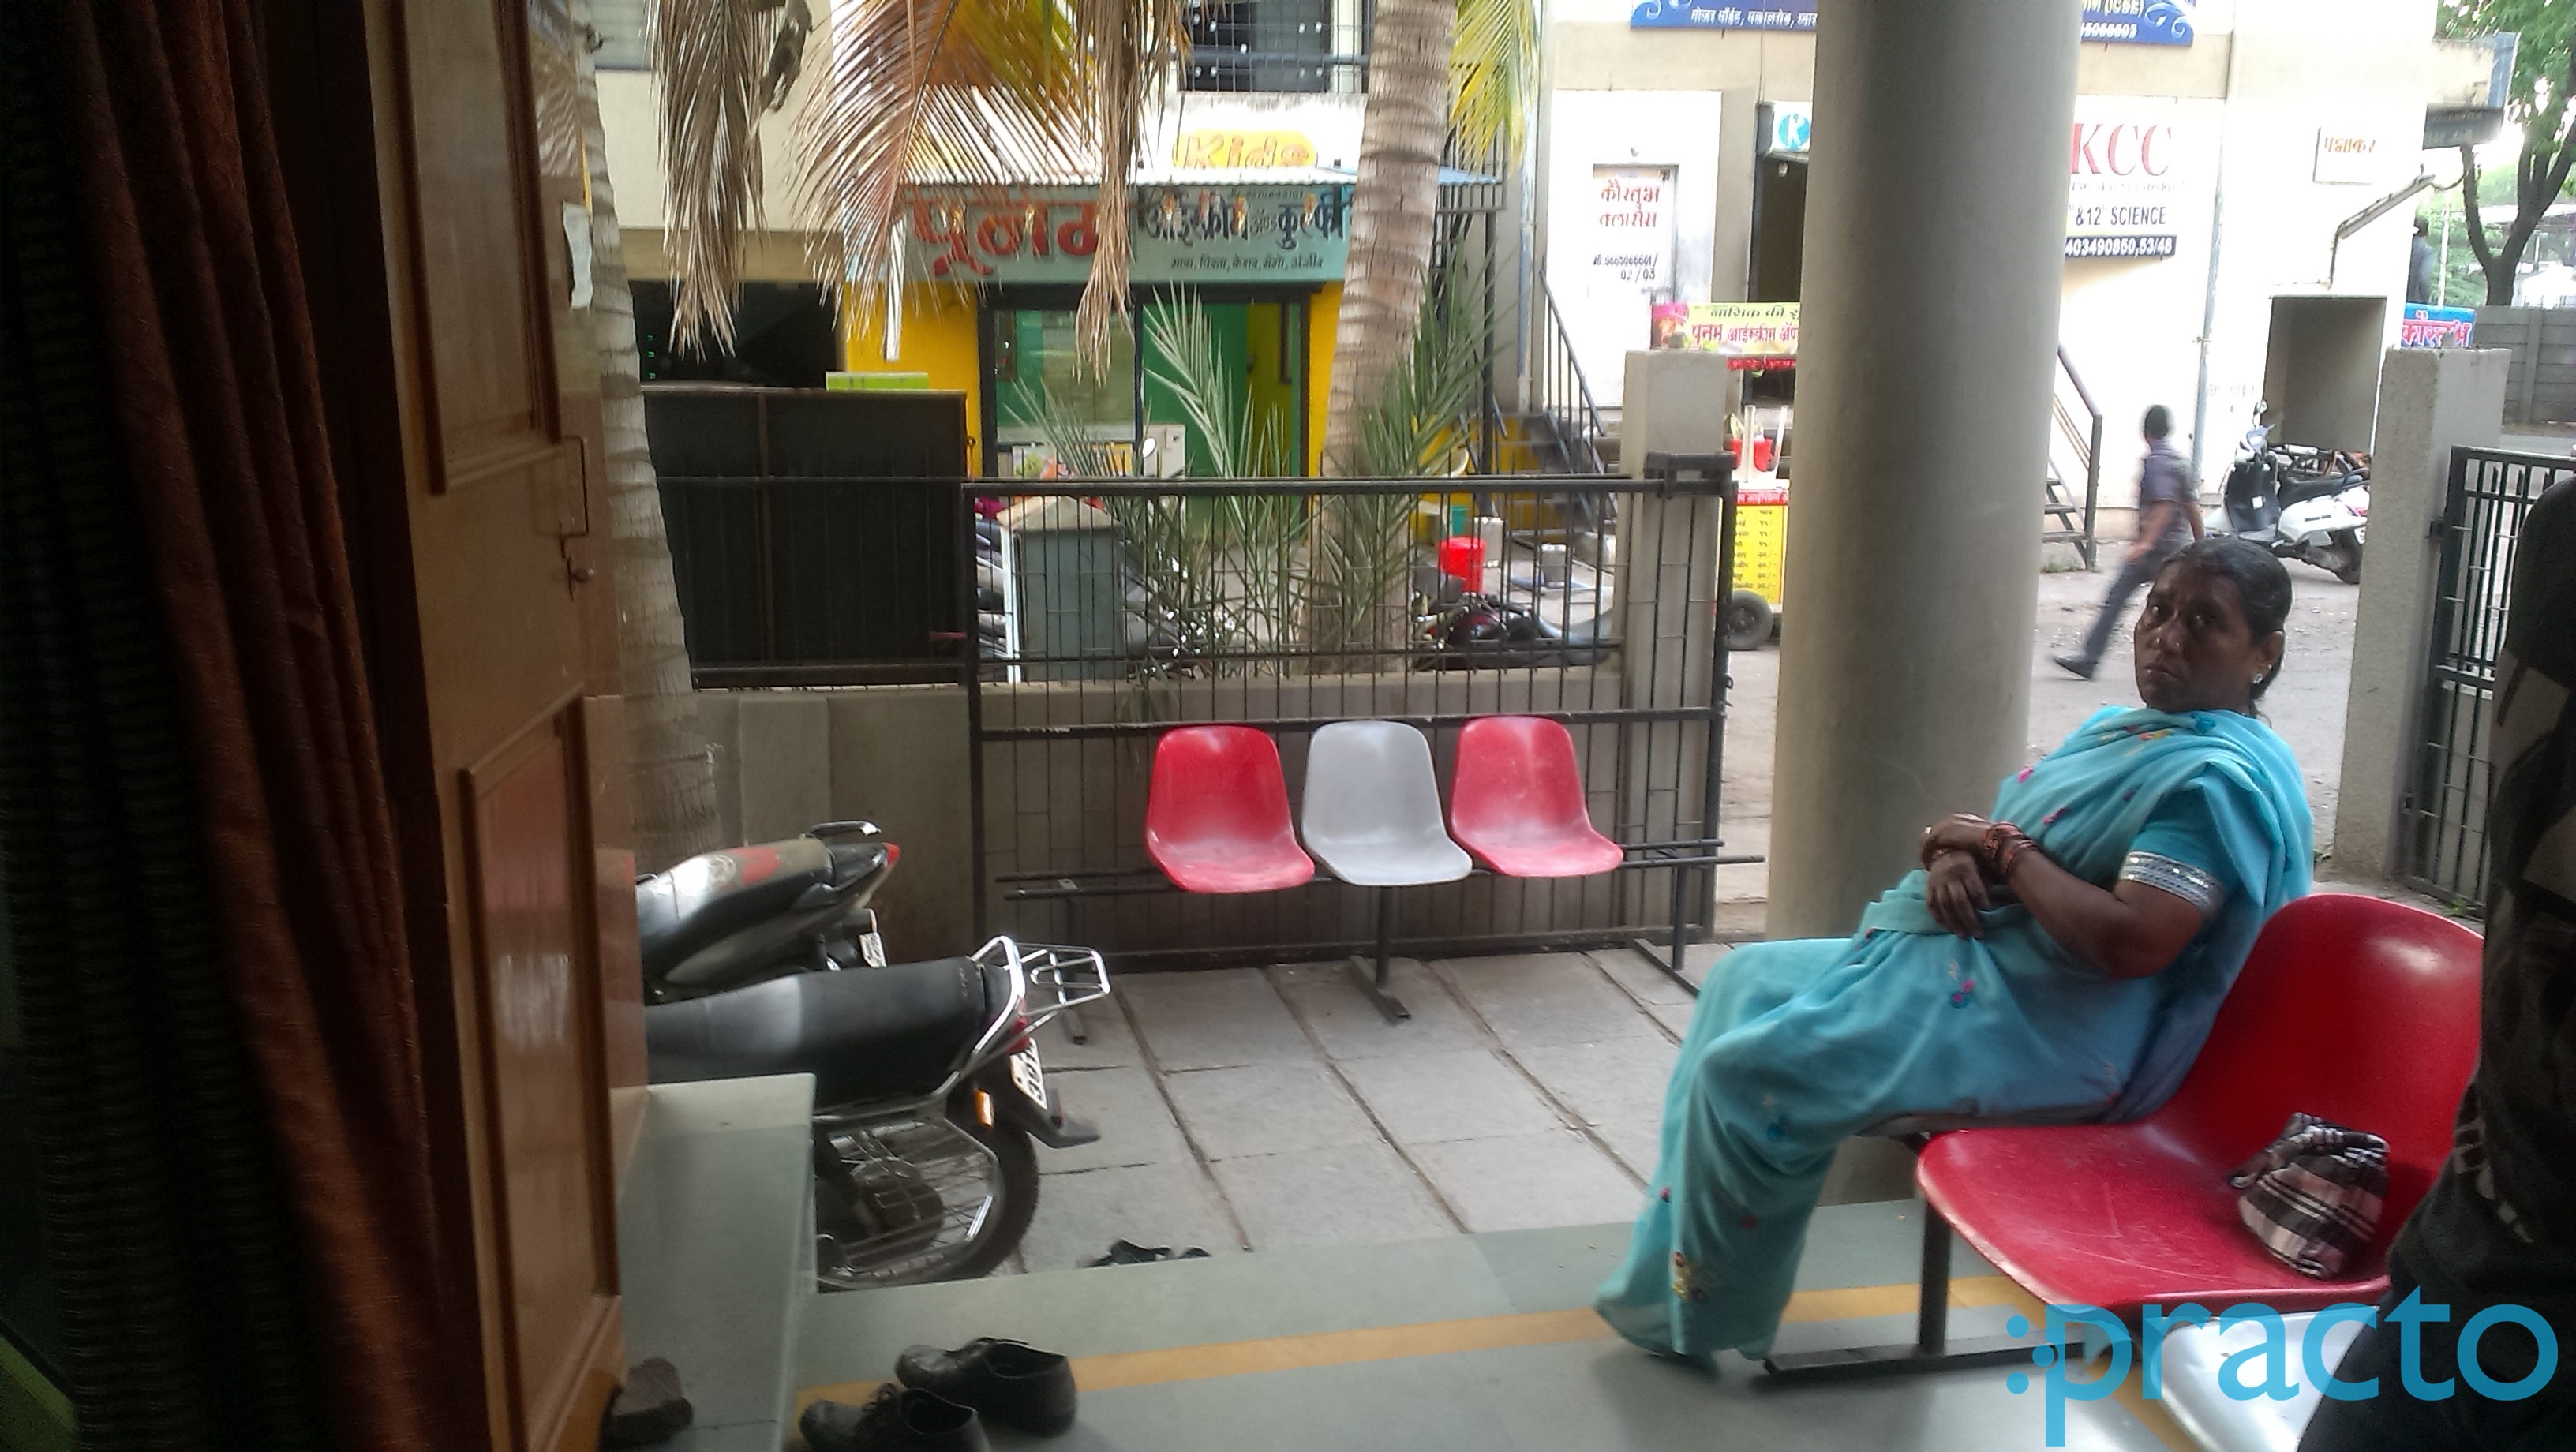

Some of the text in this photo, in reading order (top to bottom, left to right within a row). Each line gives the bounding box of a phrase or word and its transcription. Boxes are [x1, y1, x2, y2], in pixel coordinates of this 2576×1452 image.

[1183, 133, 1310, 170] Kids
[2071, 122, 2172, 176] KCC
[2110, 206, 2166, 226] SCIENCE
[2065, 238, 2173, 258] 403490850,53/48
